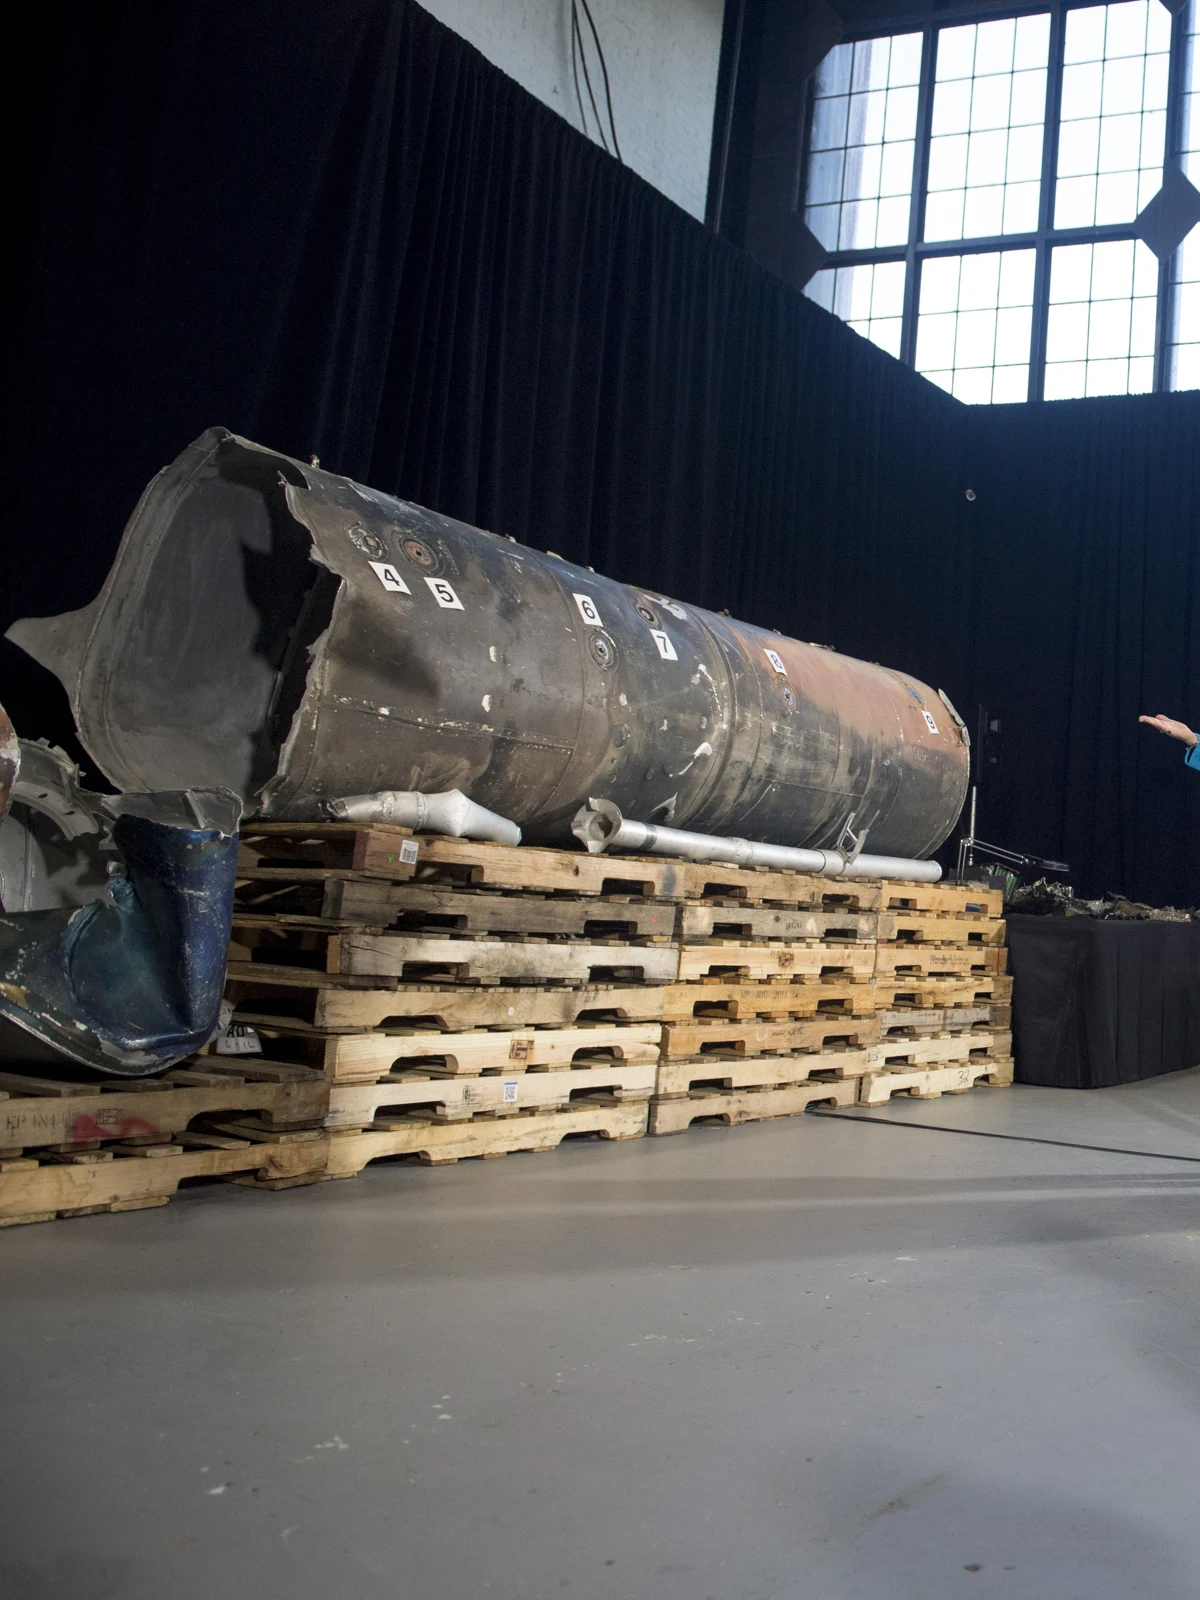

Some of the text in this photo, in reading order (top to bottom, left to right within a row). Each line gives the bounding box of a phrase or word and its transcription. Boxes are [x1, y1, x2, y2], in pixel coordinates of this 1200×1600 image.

[384, 568, 401, 586] 4
[434, 583, 455, 603] 5
[581, 600, 596, 619] 6
[656, 635, 668, 653] 7
[770, 654, 783, 669] 8
[926, 715, 935, 729] 9
